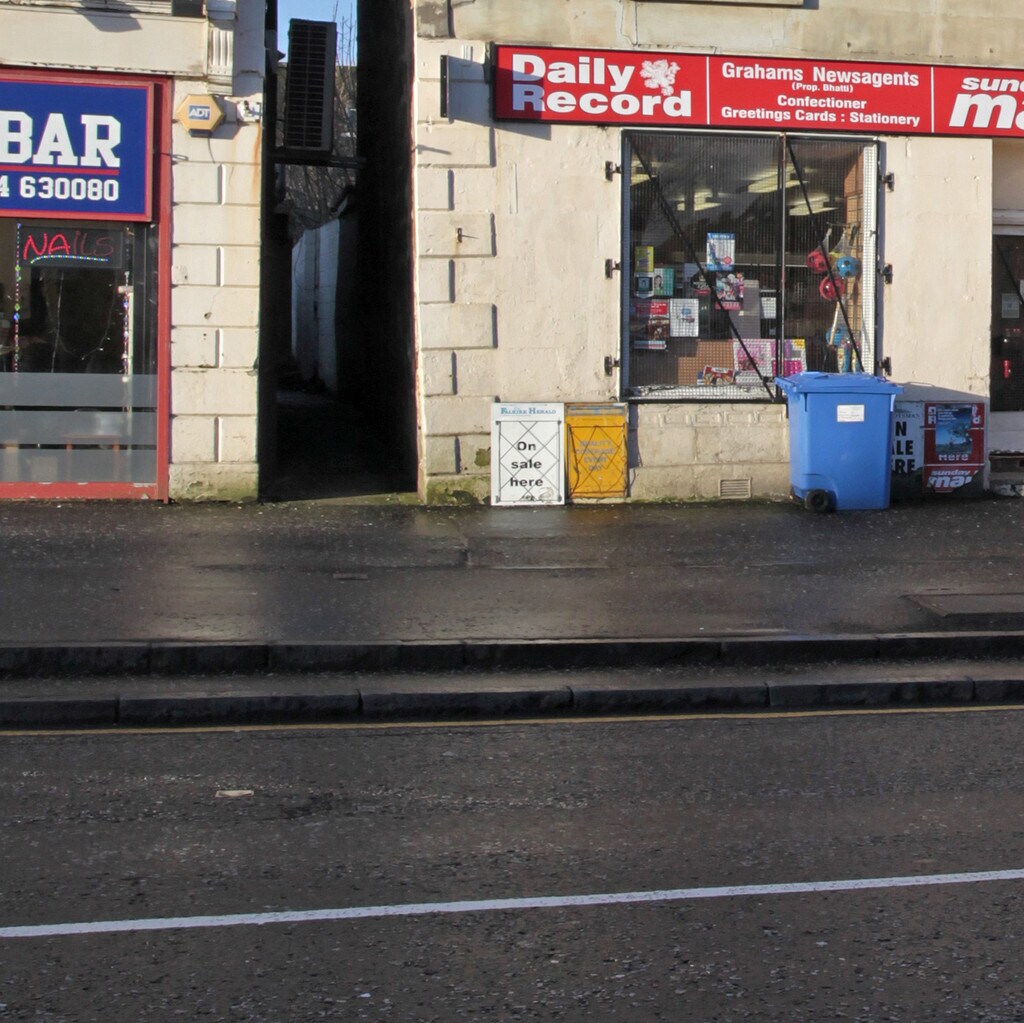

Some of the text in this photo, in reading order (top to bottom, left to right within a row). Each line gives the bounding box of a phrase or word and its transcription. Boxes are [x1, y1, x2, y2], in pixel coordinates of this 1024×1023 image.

[512, 54, 635, 93] Daily
[722, 62, 919, 88] Grahams Newsagents
[791, 82, 854, 93] (Prop. Bhatti)
[512, 84, 692, 117] Record
[777, 95, 867, 109] Confectioner
[188, 106, 211, 119] ADT
[721, 106, 791, 122] Greetings
[795, 109, 836, 122] Cards
[850, 112, 920, 127] Stationery
[0, 110, 120, 167] BAR
[19, 176, 119, 201] 630080
[23, 231, 114, 260] NAILS
[517, 441, 536, 451] On
[511, 459, 542, 469] sale
[931, 468, 970, 476] sunday
[510, 477, 543, 487] here
